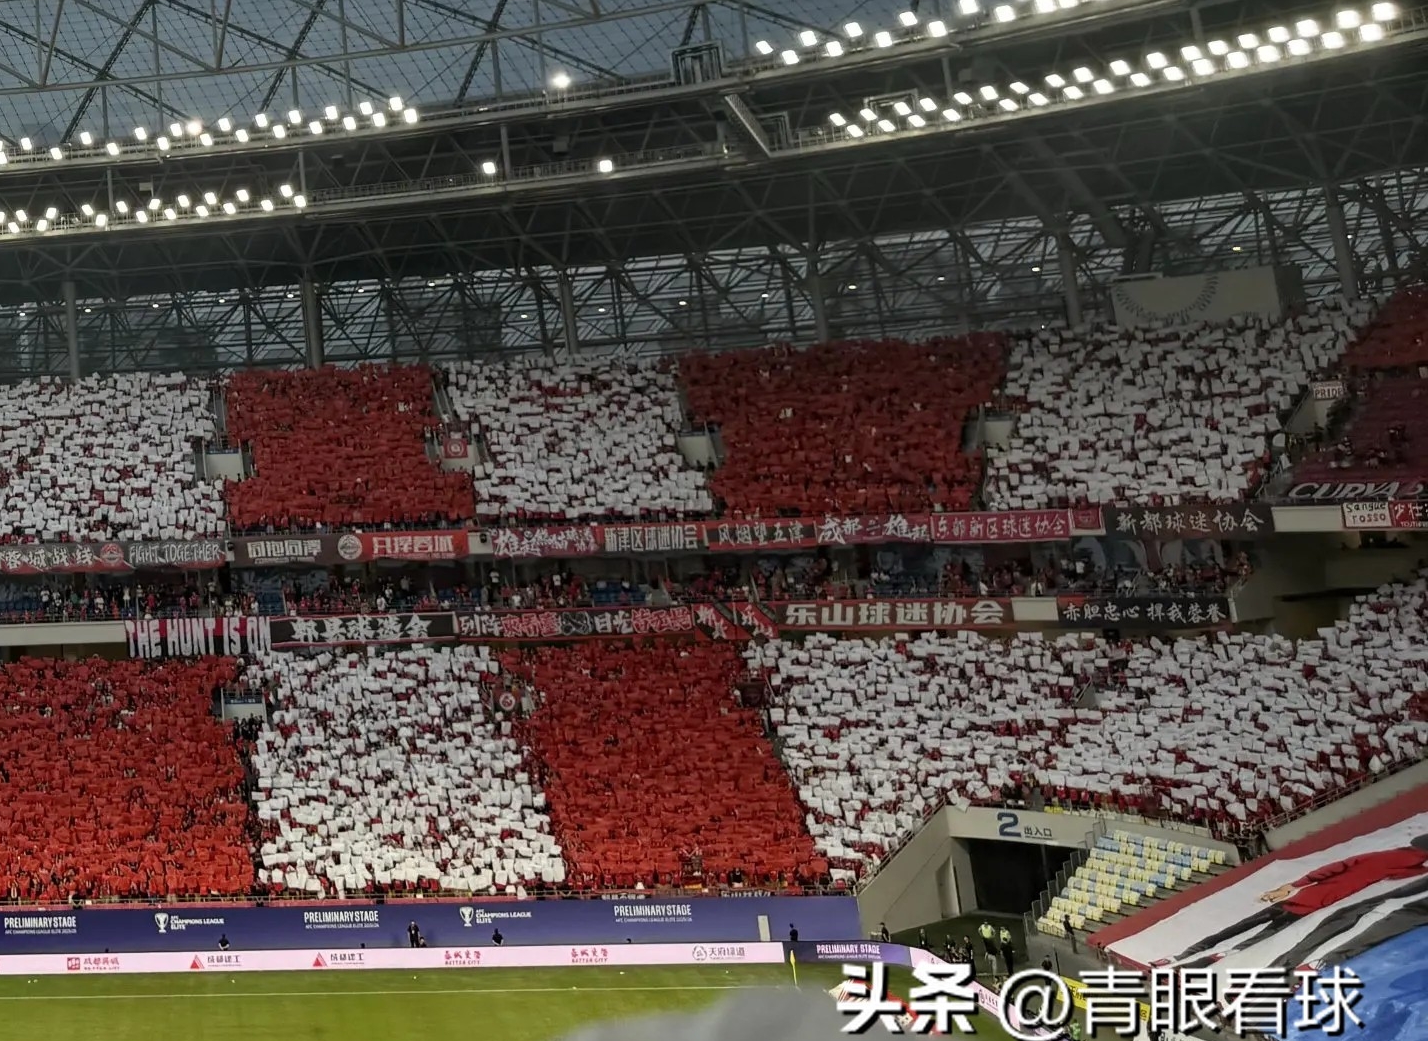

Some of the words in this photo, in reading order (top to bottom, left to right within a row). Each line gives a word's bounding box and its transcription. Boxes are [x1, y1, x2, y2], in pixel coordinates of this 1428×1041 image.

[1288, 481, 1400, 499] CURVA
[718, 521, 804, 546] 风烟望五津
[937, 513, 1065, 539] 东部新区球迷协会
[1116, 508, 1264, 535] 新都球迷协会
[605, 524, 697, 551] 新津区球迷协会
[129, 544, 160, 564] FIGHT
[162, 541, 220, 563] TOGETHER
[785, 601, 1004, 626] 乐山球迷协会
[1063, 602, 1141, 622] 赤胆忠心
[125, 619, 162, 659] THE
[166, 617, 216, 658] HUNT
[223, 617, 241, 655] IS
[247, 616, 272, 653] ON
[997, 812, 1022, 837] 2
[1024, 827, 1053, 837] 出入口
[304, 911, 354, 923] PRELIMINARY
[354, 910, 379, 922] STAGE
[614, 905, 666, 916] PRELIMINARY
[666, 904, 692, 916] STAGE
[4, 916, 53, 929] PRELIMINARY
[53, 916, 77, 928] STAGE
[816, 944, 858, 954] PRELIMINARY
[860, 944, 880, 954] STAGE
